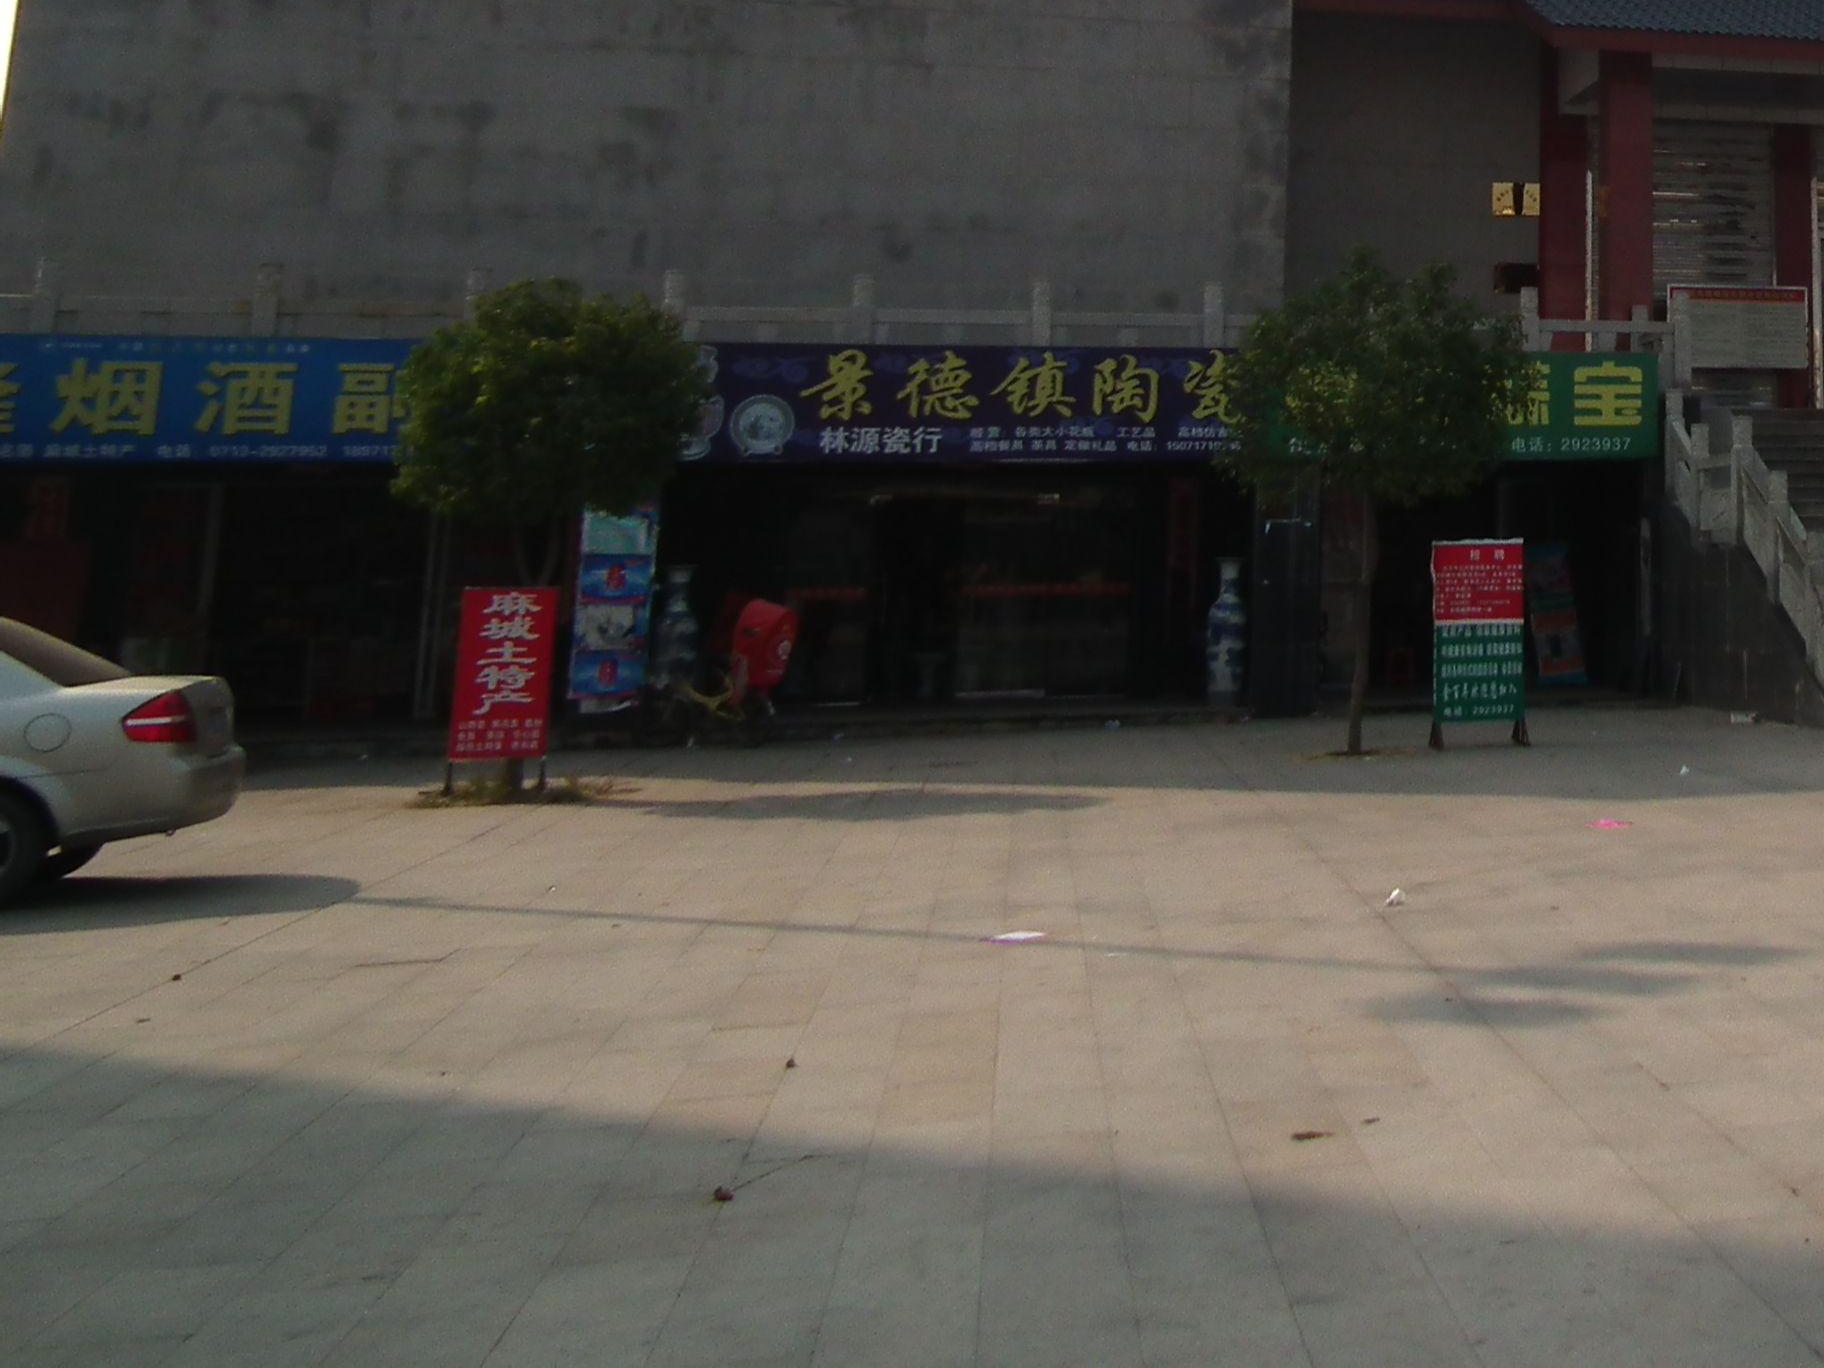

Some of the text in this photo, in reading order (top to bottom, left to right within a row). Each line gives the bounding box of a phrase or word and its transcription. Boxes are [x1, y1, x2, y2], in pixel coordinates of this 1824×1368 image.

[801, 348, 1244, 425] 景德镇陶瓷
[820, 427, 942, 454] 林源瓷行
[472, 592, 543, 715] 麻城土特产
